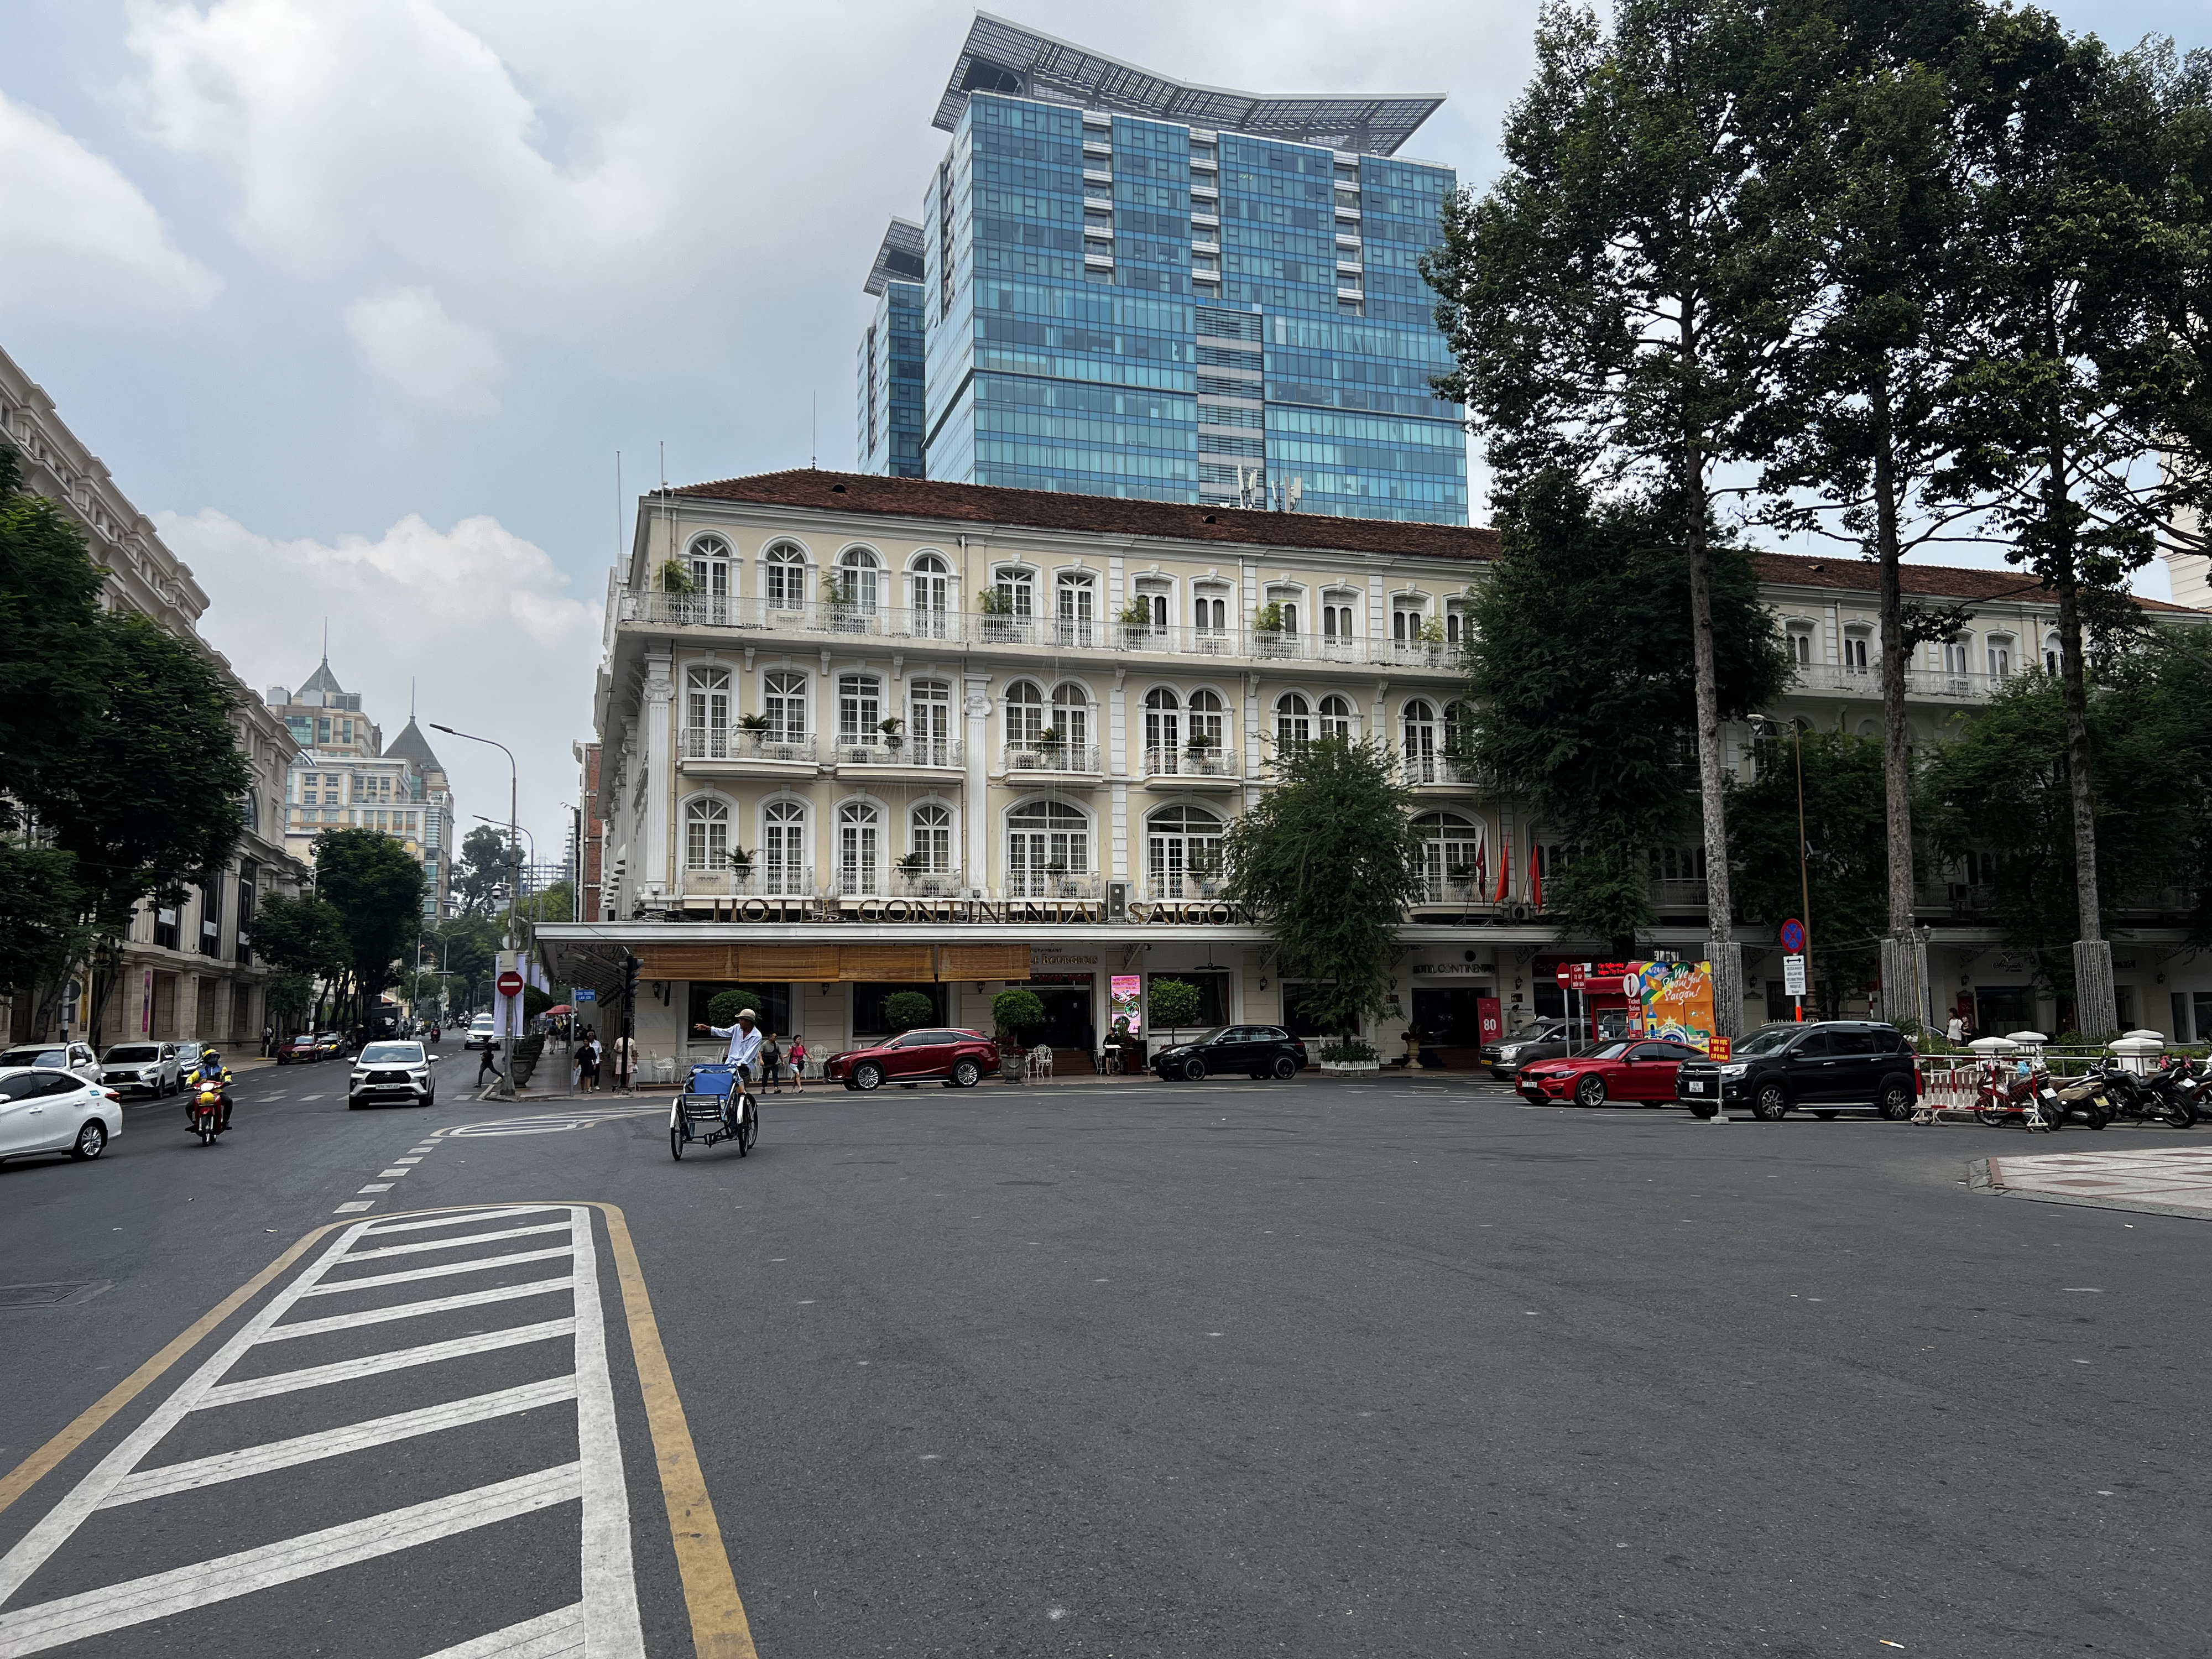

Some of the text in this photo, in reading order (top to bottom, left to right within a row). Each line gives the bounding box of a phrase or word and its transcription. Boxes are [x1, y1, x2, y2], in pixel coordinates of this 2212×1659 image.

[713, 898, 1255, 926] HOTEL CONTINENTAL SAIGON
[1674, 966, 1688, 979] We
[1662, 977, 1687, 990] Show
[1664, 985, 1701, 1005] Saigon!
[1483, 1019, 1496, 1031] 80
